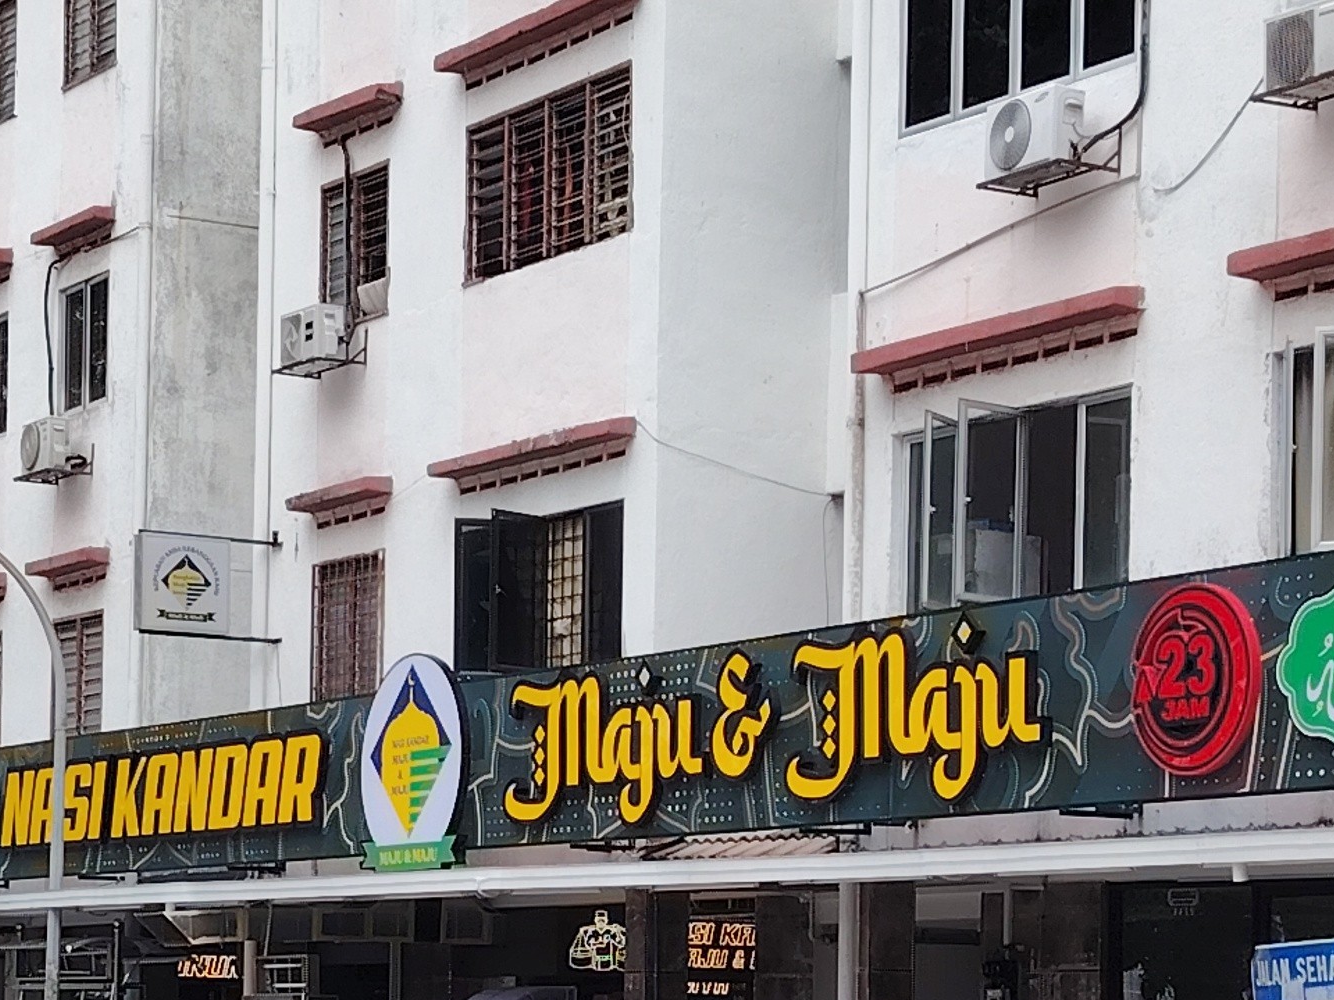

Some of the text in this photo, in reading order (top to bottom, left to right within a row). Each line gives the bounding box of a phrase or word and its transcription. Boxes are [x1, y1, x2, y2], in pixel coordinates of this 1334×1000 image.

[1156, 634, 1215, 697] 23
[1161, 698, 1210, 721] JAM
[503, 611, 1041, 824] Maju & Maju
[0, 733, 322, 847] NASI KANDAR
